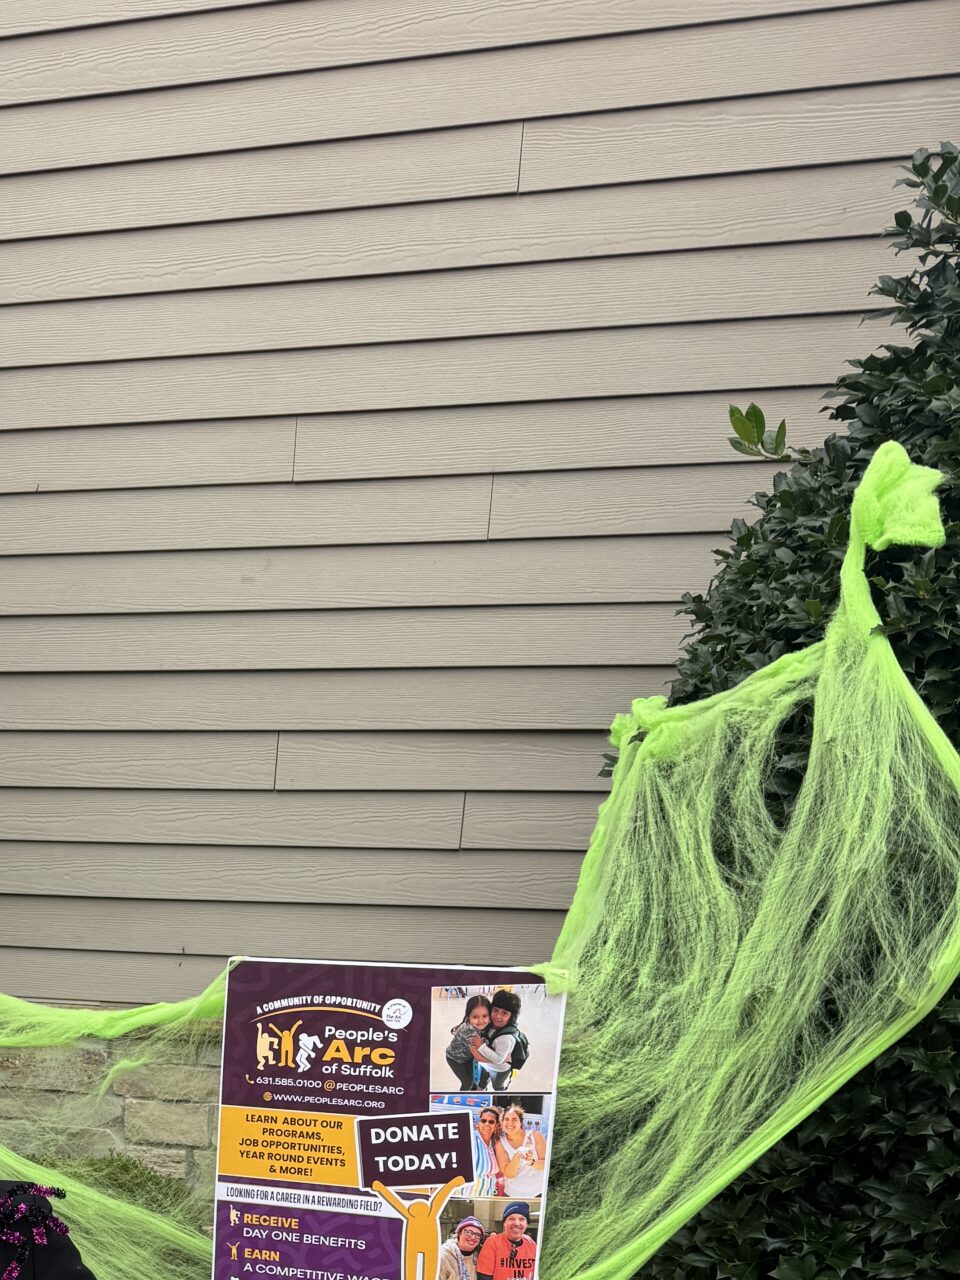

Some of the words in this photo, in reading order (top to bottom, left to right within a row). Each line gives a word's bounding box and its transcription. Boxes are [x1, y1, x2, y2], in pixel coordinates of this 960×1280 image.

[256, 1005, 263, 1015] A
[263, 995, 312, 1012] COMMUNITY
[313, 995, 324, 1004] OF
[325, 995, 382, 1013] OPPORTUNITY
[324, 1025, 398, 1043] People's
[322, 1039, 396, 1065] Arc
[322, 1063, 338, 1074] of
[341, 1064, 394, 1079] Suffolk
[256, 1076, 322, 1089] 631.585.0100
[273, 1093, 385, 1109] WWW.PEOPLESARC.ORG
[245, 1113, 278, 1124] LEARN
[282, 1117, 319, 1128] ABOUT
[320, 1120, 343, 1130] OUR
[262, 1127, 324, 1142] PROGRAMS,
[370, 1122, 460, 1144] DONATE
[238, 1138, 259, 1147] JOB
[261, 1140, 345, 1157] OPPORTUNITIES,
[239, 1150, 265, 1160] YEAR
[267, 1152, 304, 1163] ROUND
[306, 1156, 346, 1167] EVENTS
[374, 1152, 457, 1173] TODAY!
[269, 1165, 277, 1173] &
[279, 1166, 313, 1177] MORE!
[226, 1186, 255, 1199] LOOKING
[256, 1189, 269, 1201] FOR
[270, 1191, 275, 1201] A
[276, 1191, 301, 1204] CAREER
[302, 1194, 310, 1205] IN
[310, 1195, 316, 1205] A
[317, 1196, 359, 1210] REWARDING
[360, 1201, 383, 1212] FIELD?
[243, 1213, 299, 1229] RECEIVE
[243, 1228, 269, 1239] DAY
[271, 1231, 300, 1243] ONE
[303, 1234, 366, 1250] BENEFITS
[244, 1248, 280, 1262] EARN
[243, 1263, 253, 1272] A
[513, 1270, 525, 1278] IN
